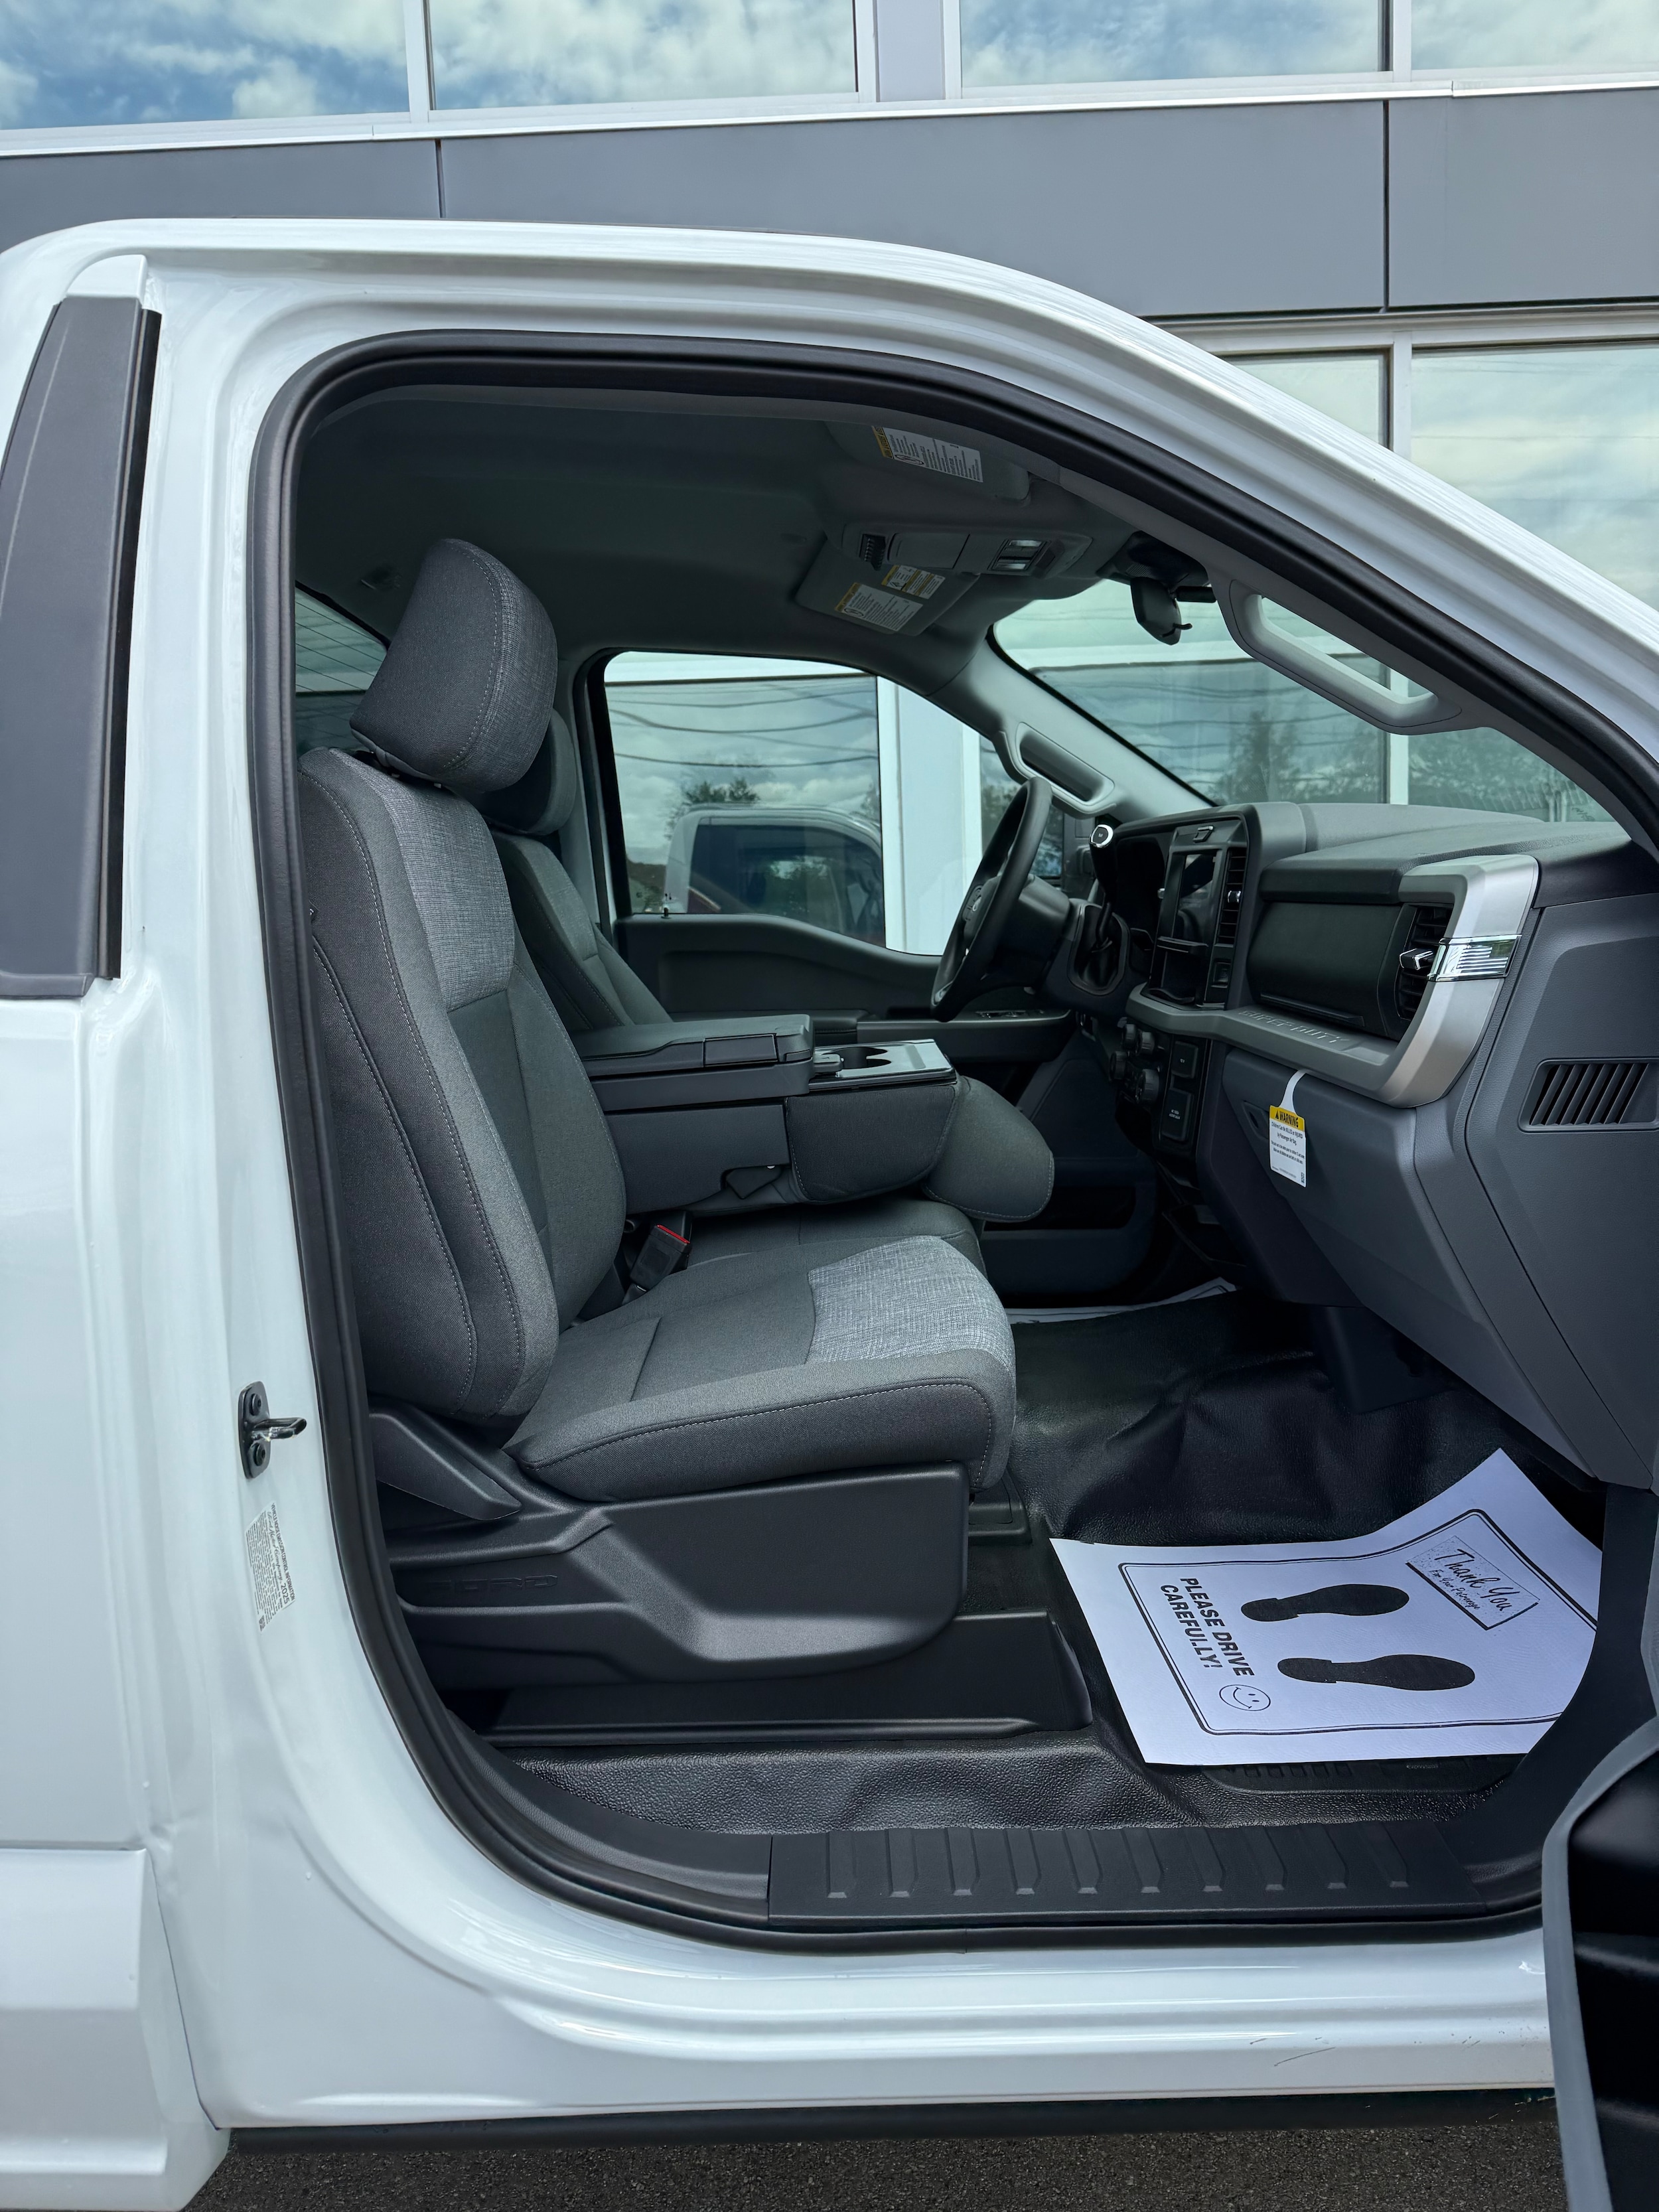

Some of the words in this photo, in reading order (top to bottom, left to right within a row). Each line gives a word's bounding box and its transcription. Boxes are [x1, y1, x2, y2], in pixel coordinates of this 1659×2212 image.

[1279, 1110, 1299, 1128] WARNING
[281, 1583, 289, 1604] 2025
[285, 1572, 295, 1601] INFORMATION
[425, 1574, 557, 1591] FORD
[1434, 1548, 1501, 1588] Thank
[1480, 1587, 1520, 1611] You
[1161, 1585, 1223, 1668] CAREFULLY!
[1180, 1578, 1226, 1627] PLEASE
[1212, 1632, 1255, 1676] DRIVE
